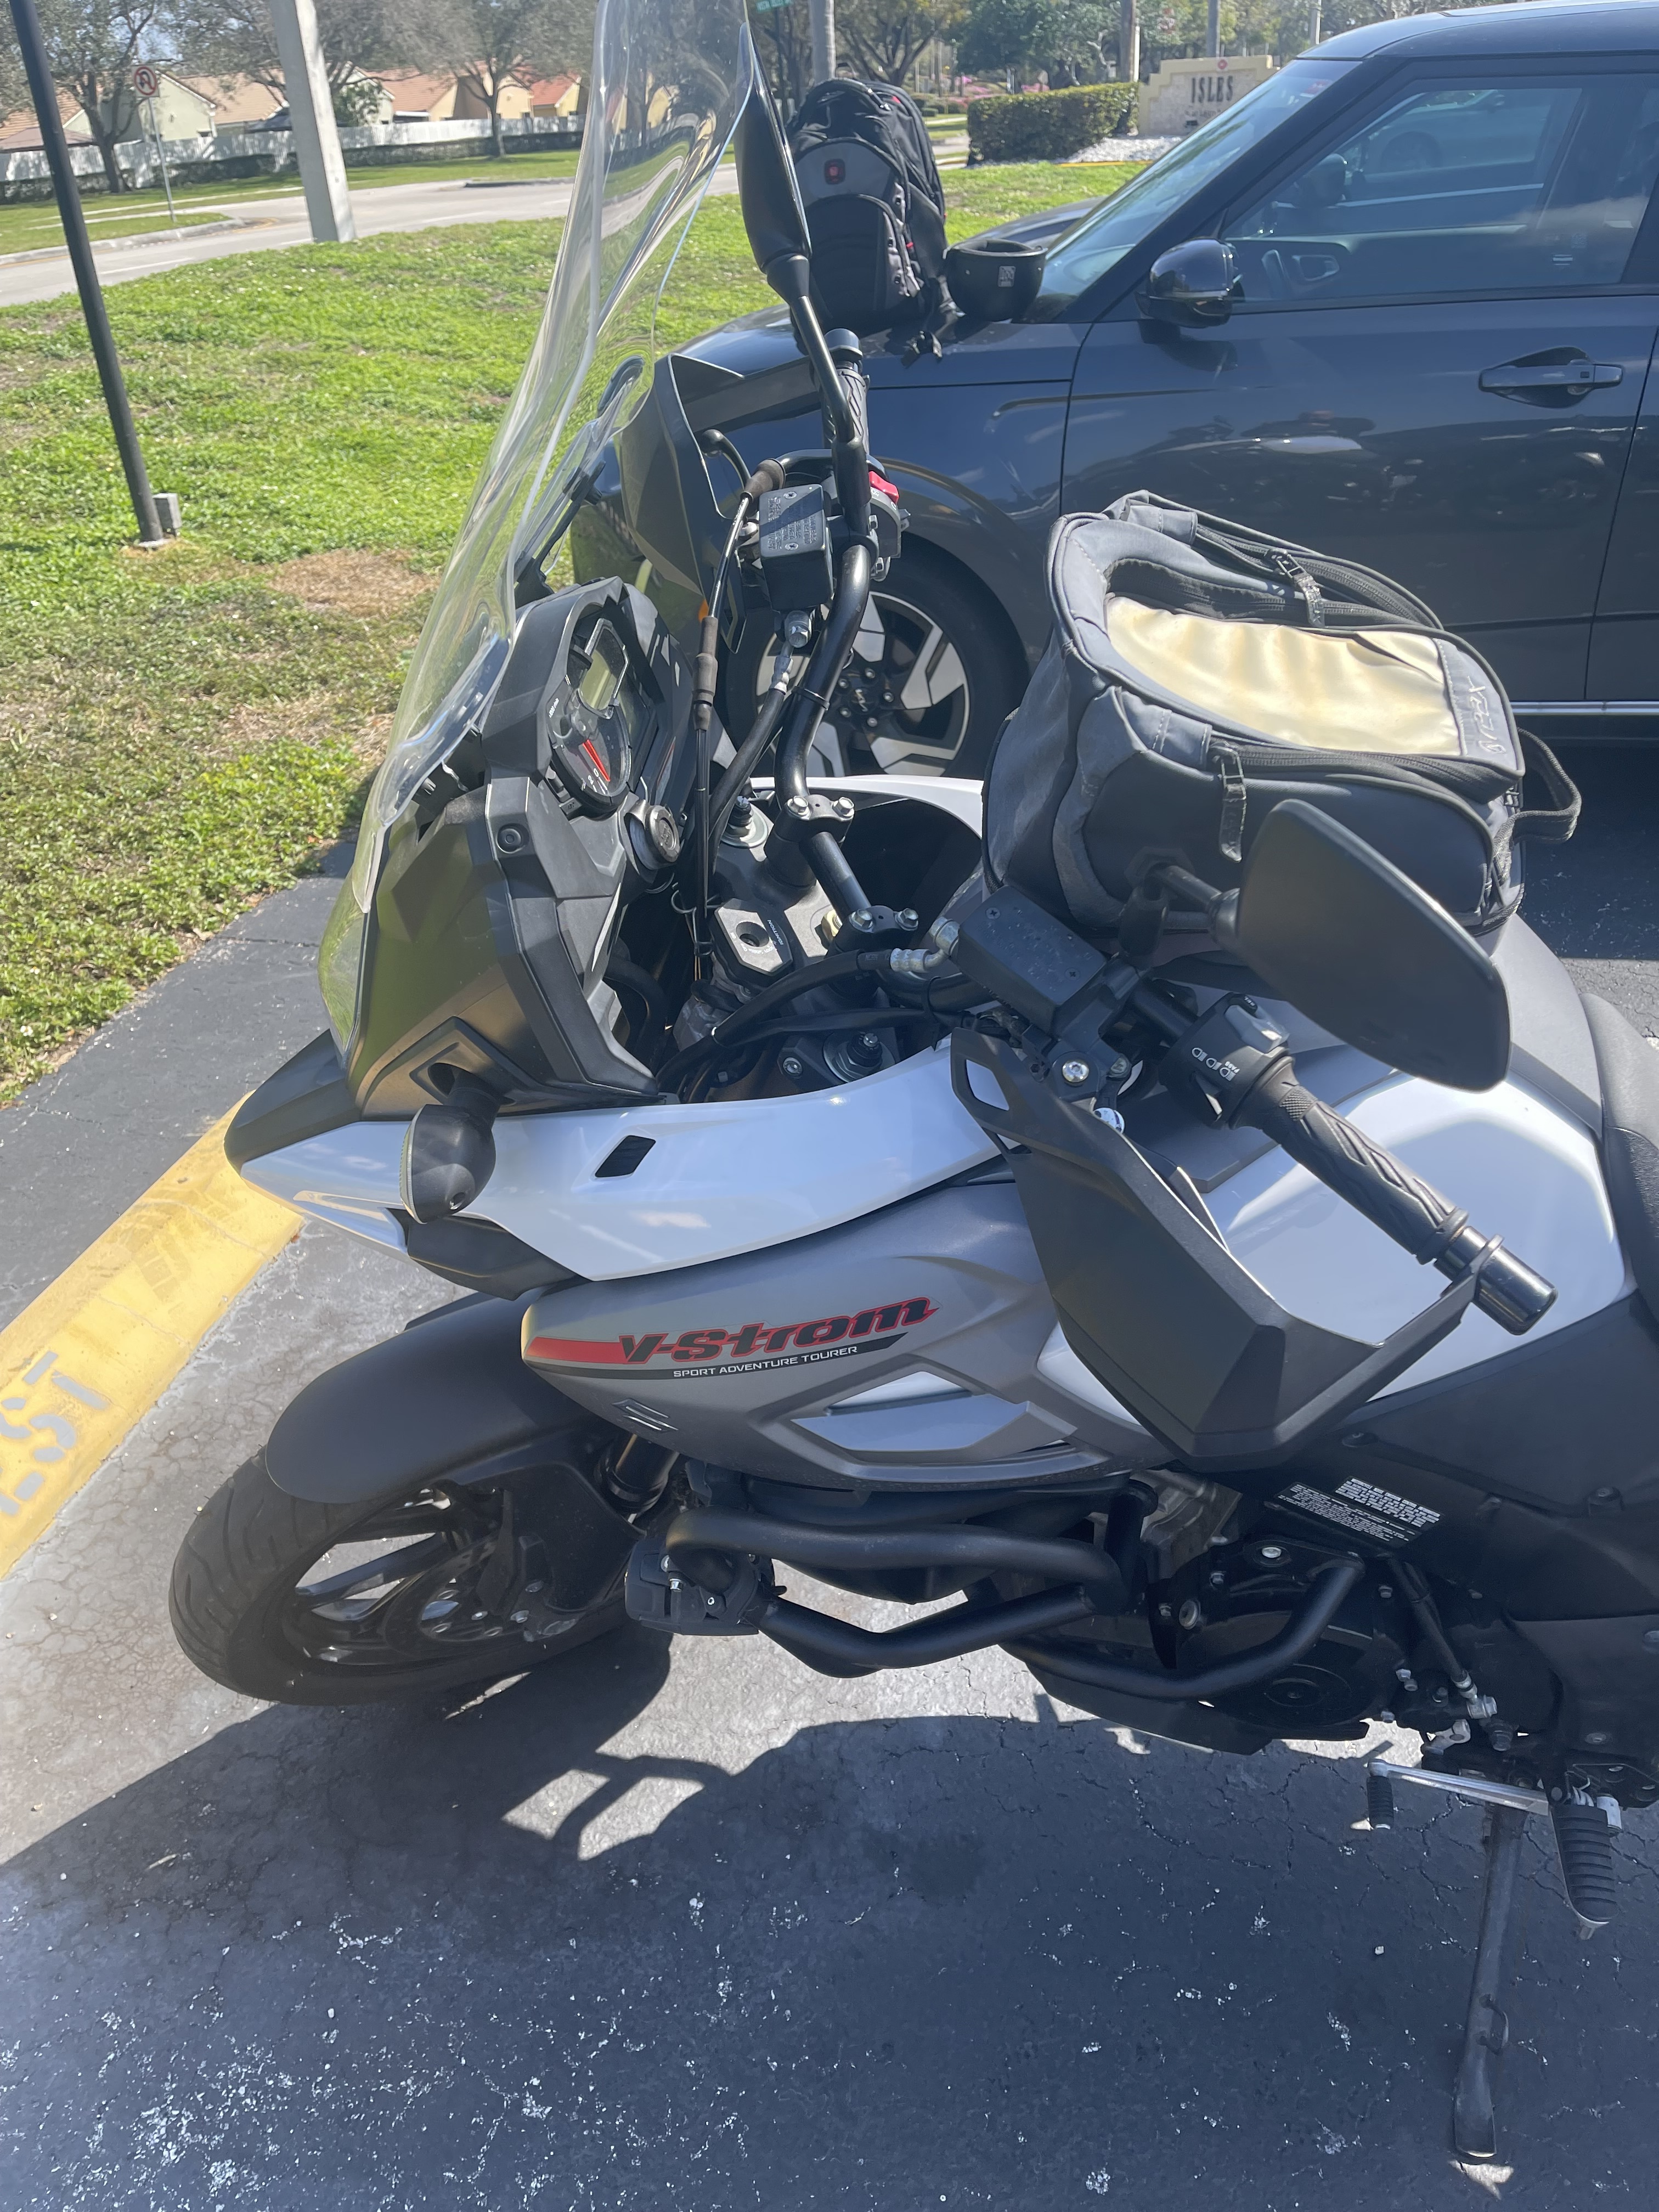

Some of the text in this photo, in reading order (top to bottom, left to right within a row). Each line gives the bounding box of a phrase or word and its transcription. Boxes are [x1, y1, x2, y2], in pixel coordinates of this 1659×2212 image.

[1190, 75, 1234, 104] ISLES
[767, 919, 784, 945] IGNITION
[1224, 1061, 1240, 1073] PASS
[618, 1297, 939, 1364] V-Strom
[673, 1346, 857, 1378] SPORT ADVENTURE TOURER
